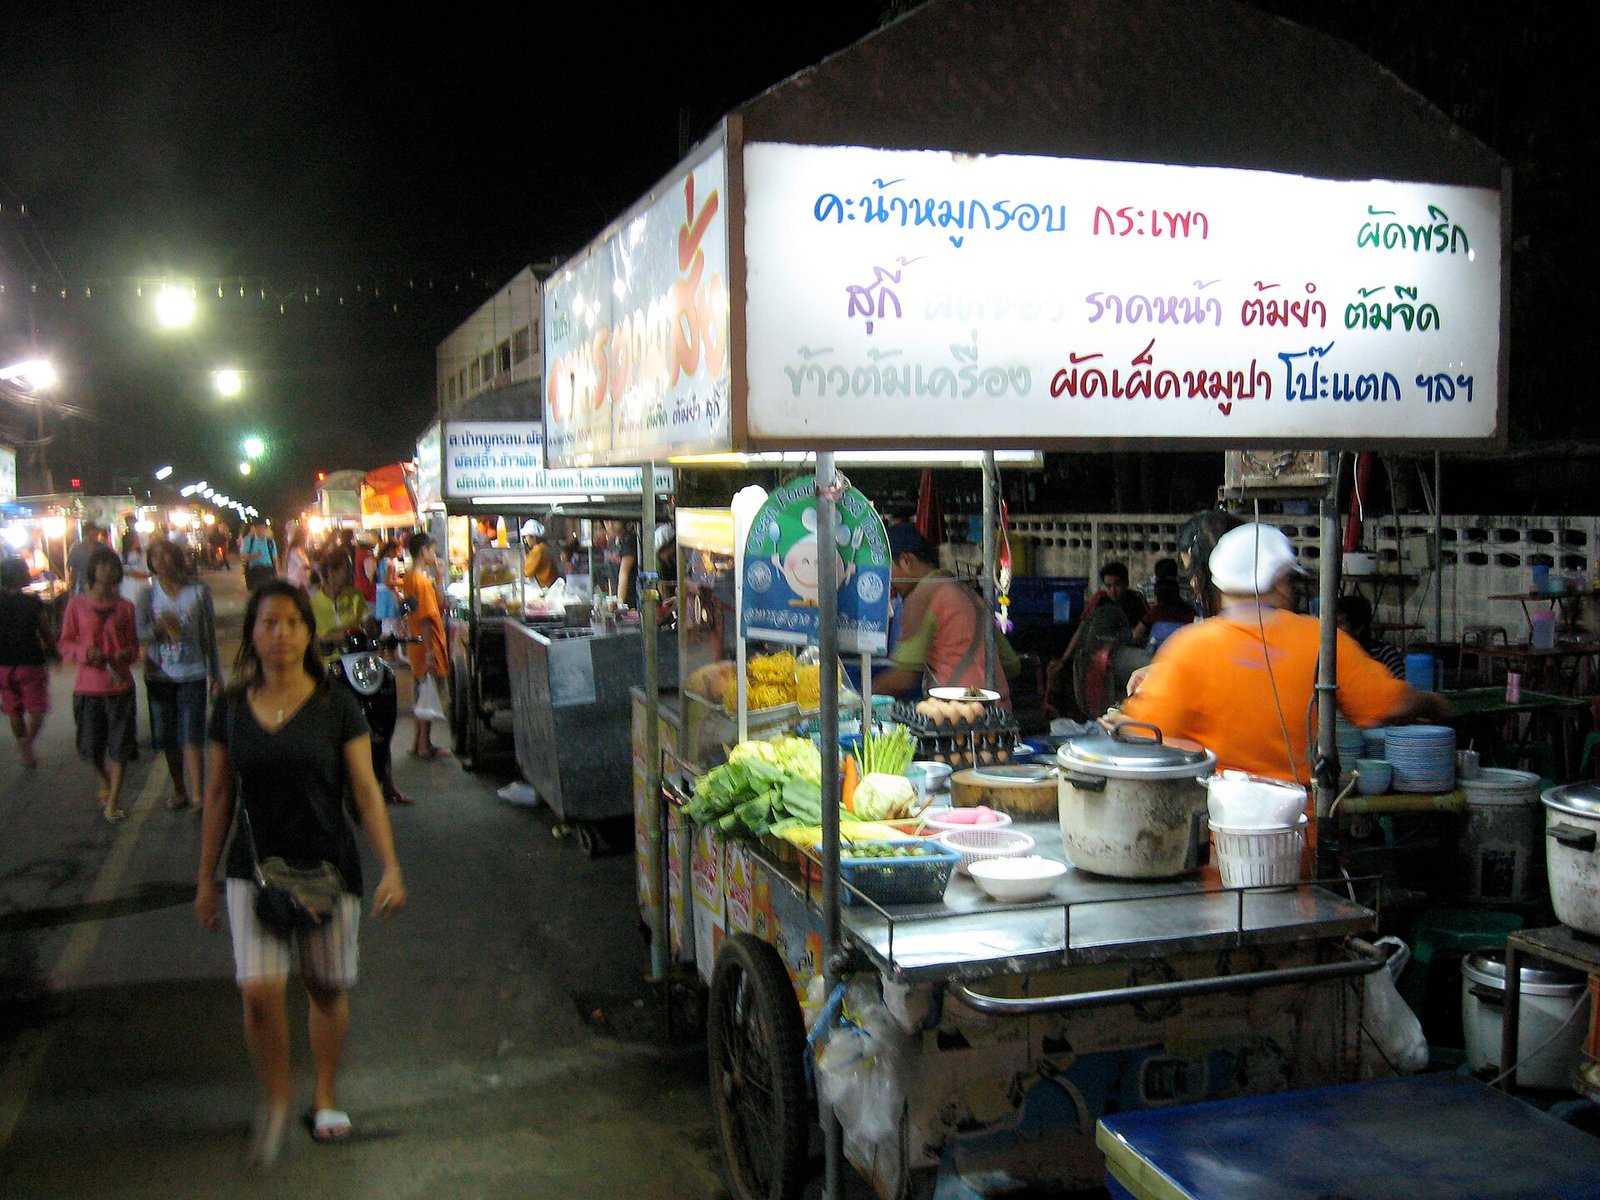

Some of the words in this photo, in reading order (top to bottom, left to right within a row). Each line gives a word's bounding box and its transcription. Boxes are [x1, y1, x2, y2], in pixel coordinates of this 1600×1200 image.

[814, 178, 1066, 249] คะน้าหมูกรอบ
[1093, 205, 1209, 240] กระเพา
[1357, 204, 1469, 254] ผัดพริก
[845, 255, 928, 335] สุกี้
[1085, 279, 1222, 327] ราดหน้า
[1241, 280, 1327, 328] ต้มยำ
[1344, 285, 1440, 331] ต้มจืด
[783, 327, 1032, 399] ข้าวต้มเครื่อง
[1278, 340, 1402, 402] โป๊ะแตก
[1415, 372, 1475, 403] ฯลฯ
[775, 477, 817, 510] Food
[861, 509, 886, 566] Taste
